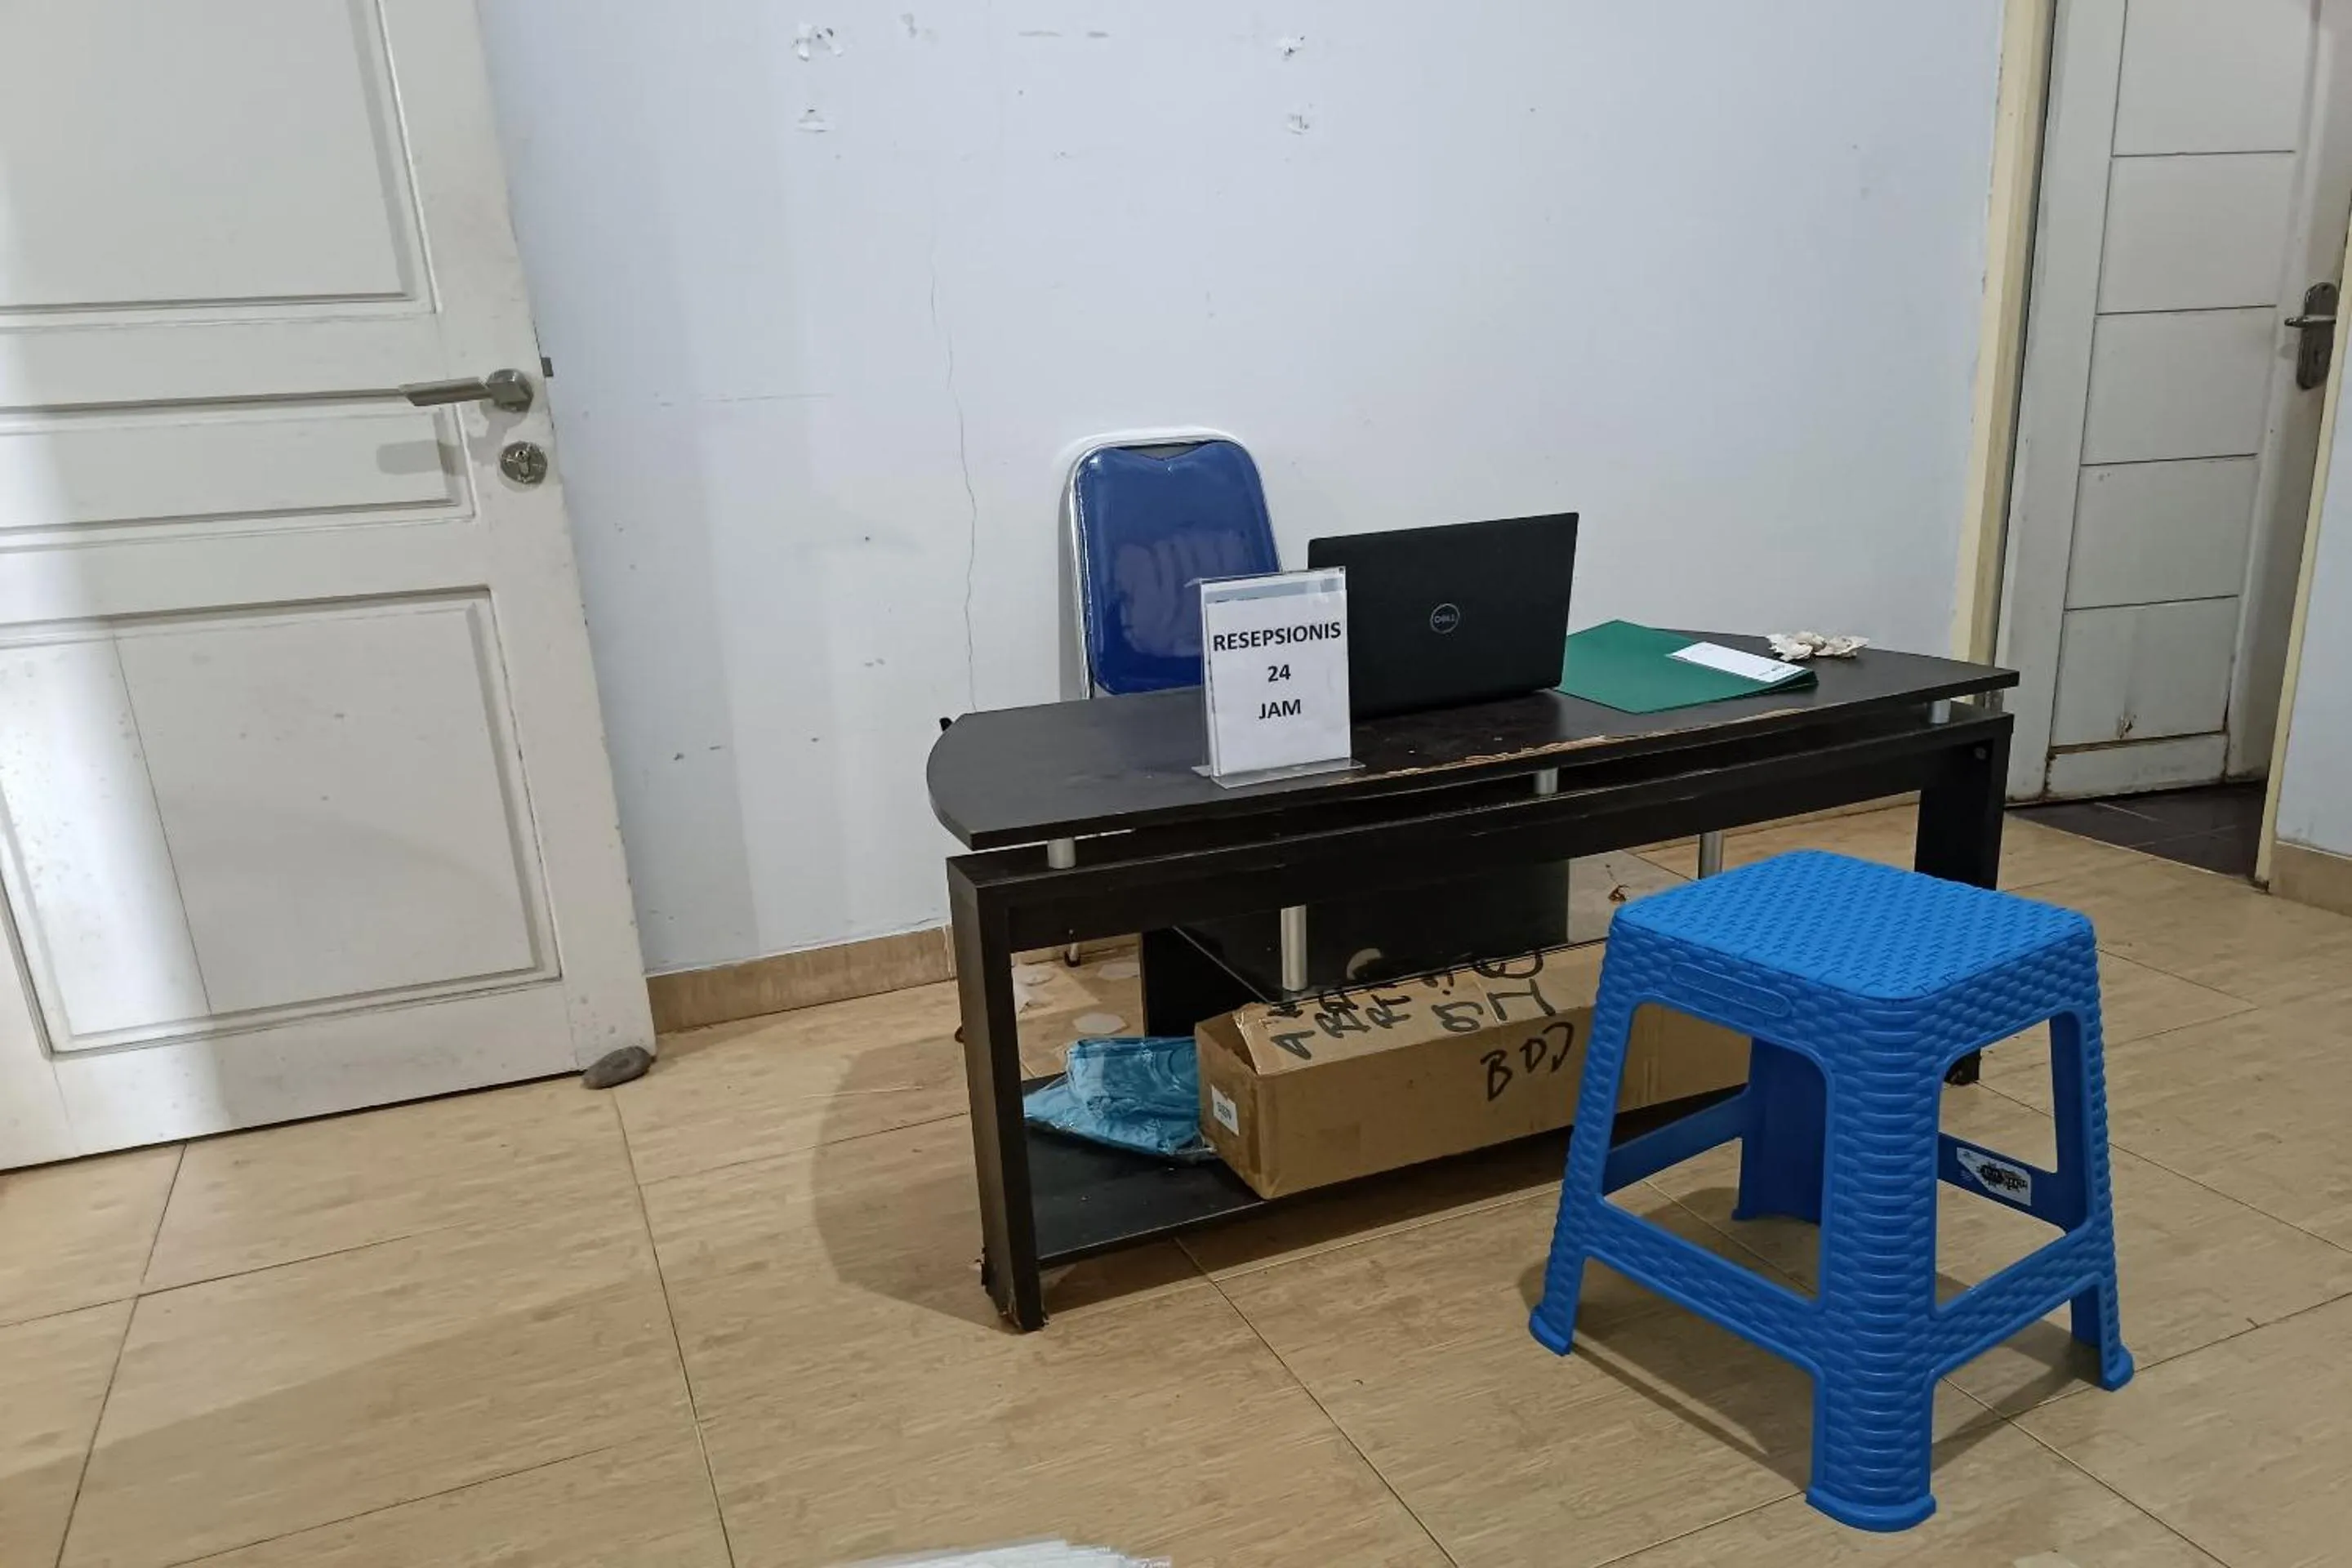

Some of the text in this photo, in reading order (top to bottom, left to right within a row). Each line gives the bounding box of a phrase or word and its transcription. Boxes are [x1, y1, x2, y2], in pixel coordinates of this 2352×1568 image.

[1213, 621, 1342, 652] RESEPSIONIS
[1267, 664, 1291, 684] 24
[1258, 699, 1302, 719] JAM
